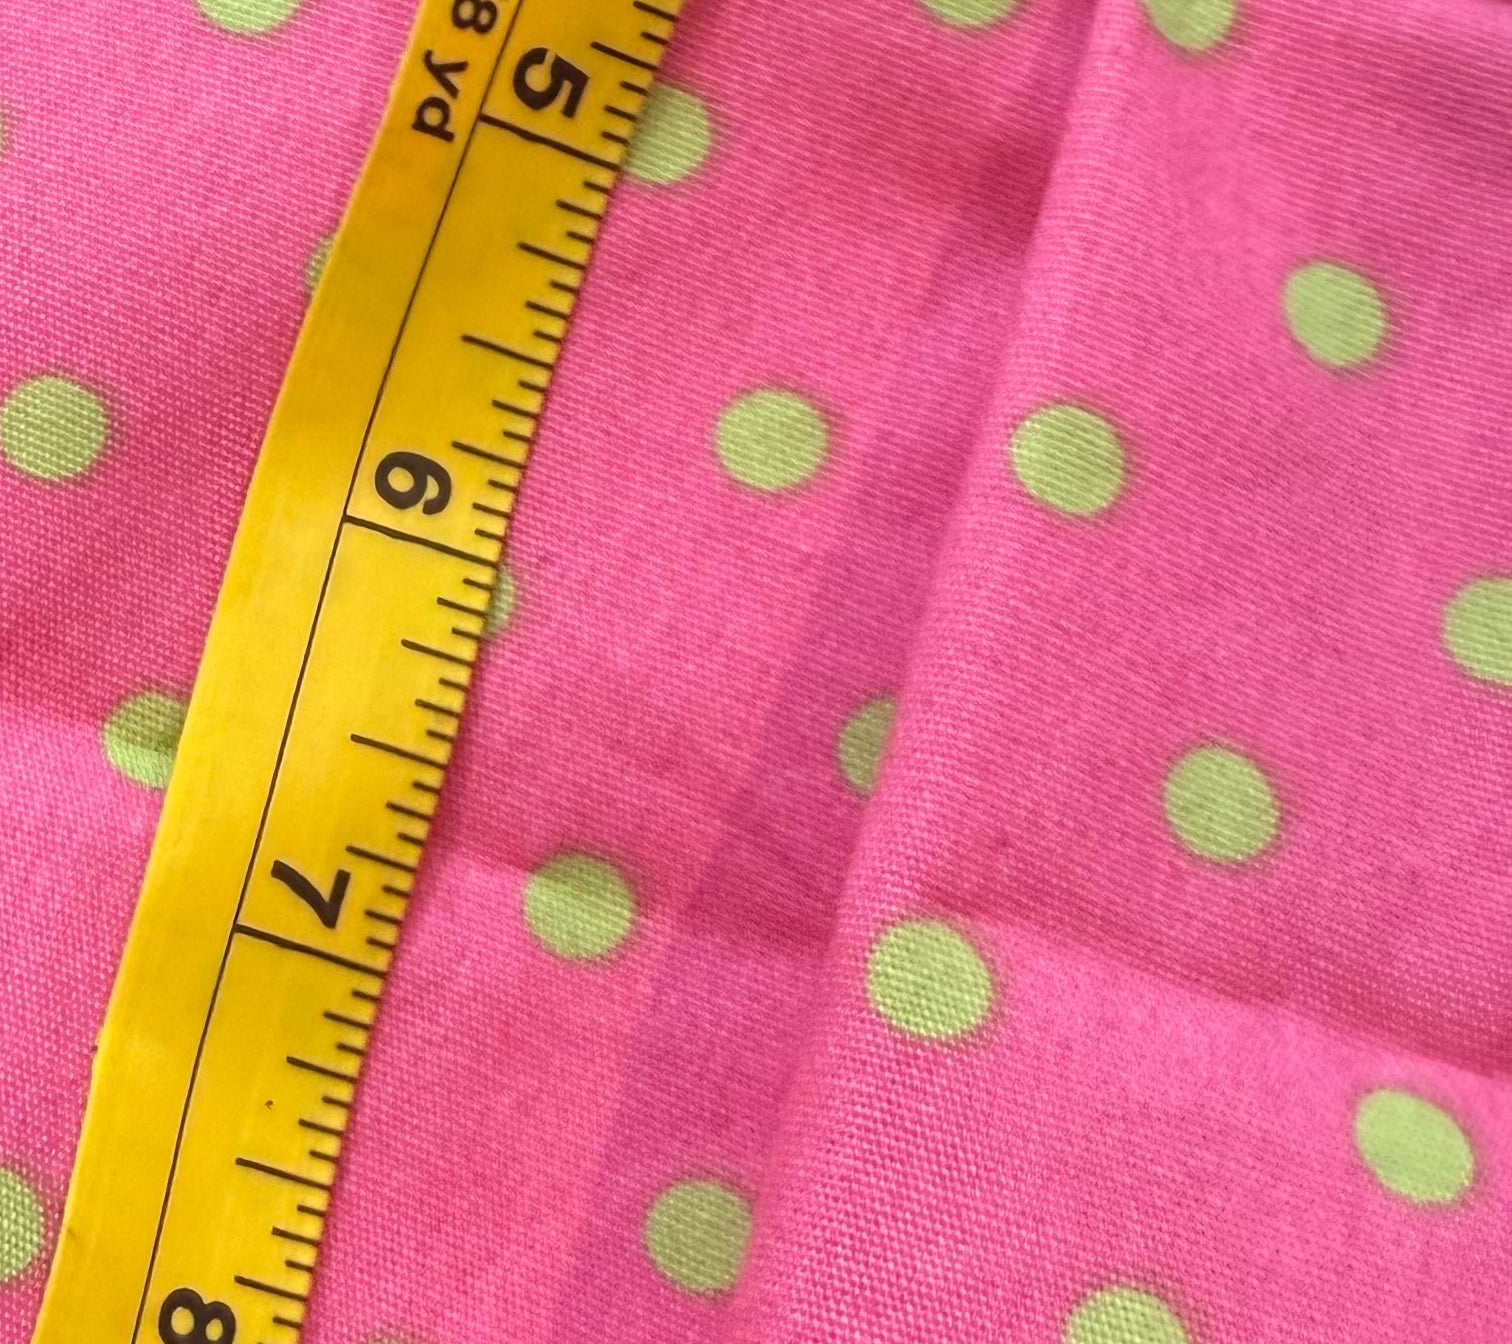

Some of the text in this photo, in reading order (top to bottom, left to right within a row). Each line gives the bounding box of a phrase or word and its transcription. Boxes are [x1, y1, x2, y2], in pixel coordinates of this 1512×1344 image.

[411, 49, 469, 143] yd
[512, 47, 589, 119] 5
[374, 452, 451, 517] 6
[272, 860, 350, 929] 7
